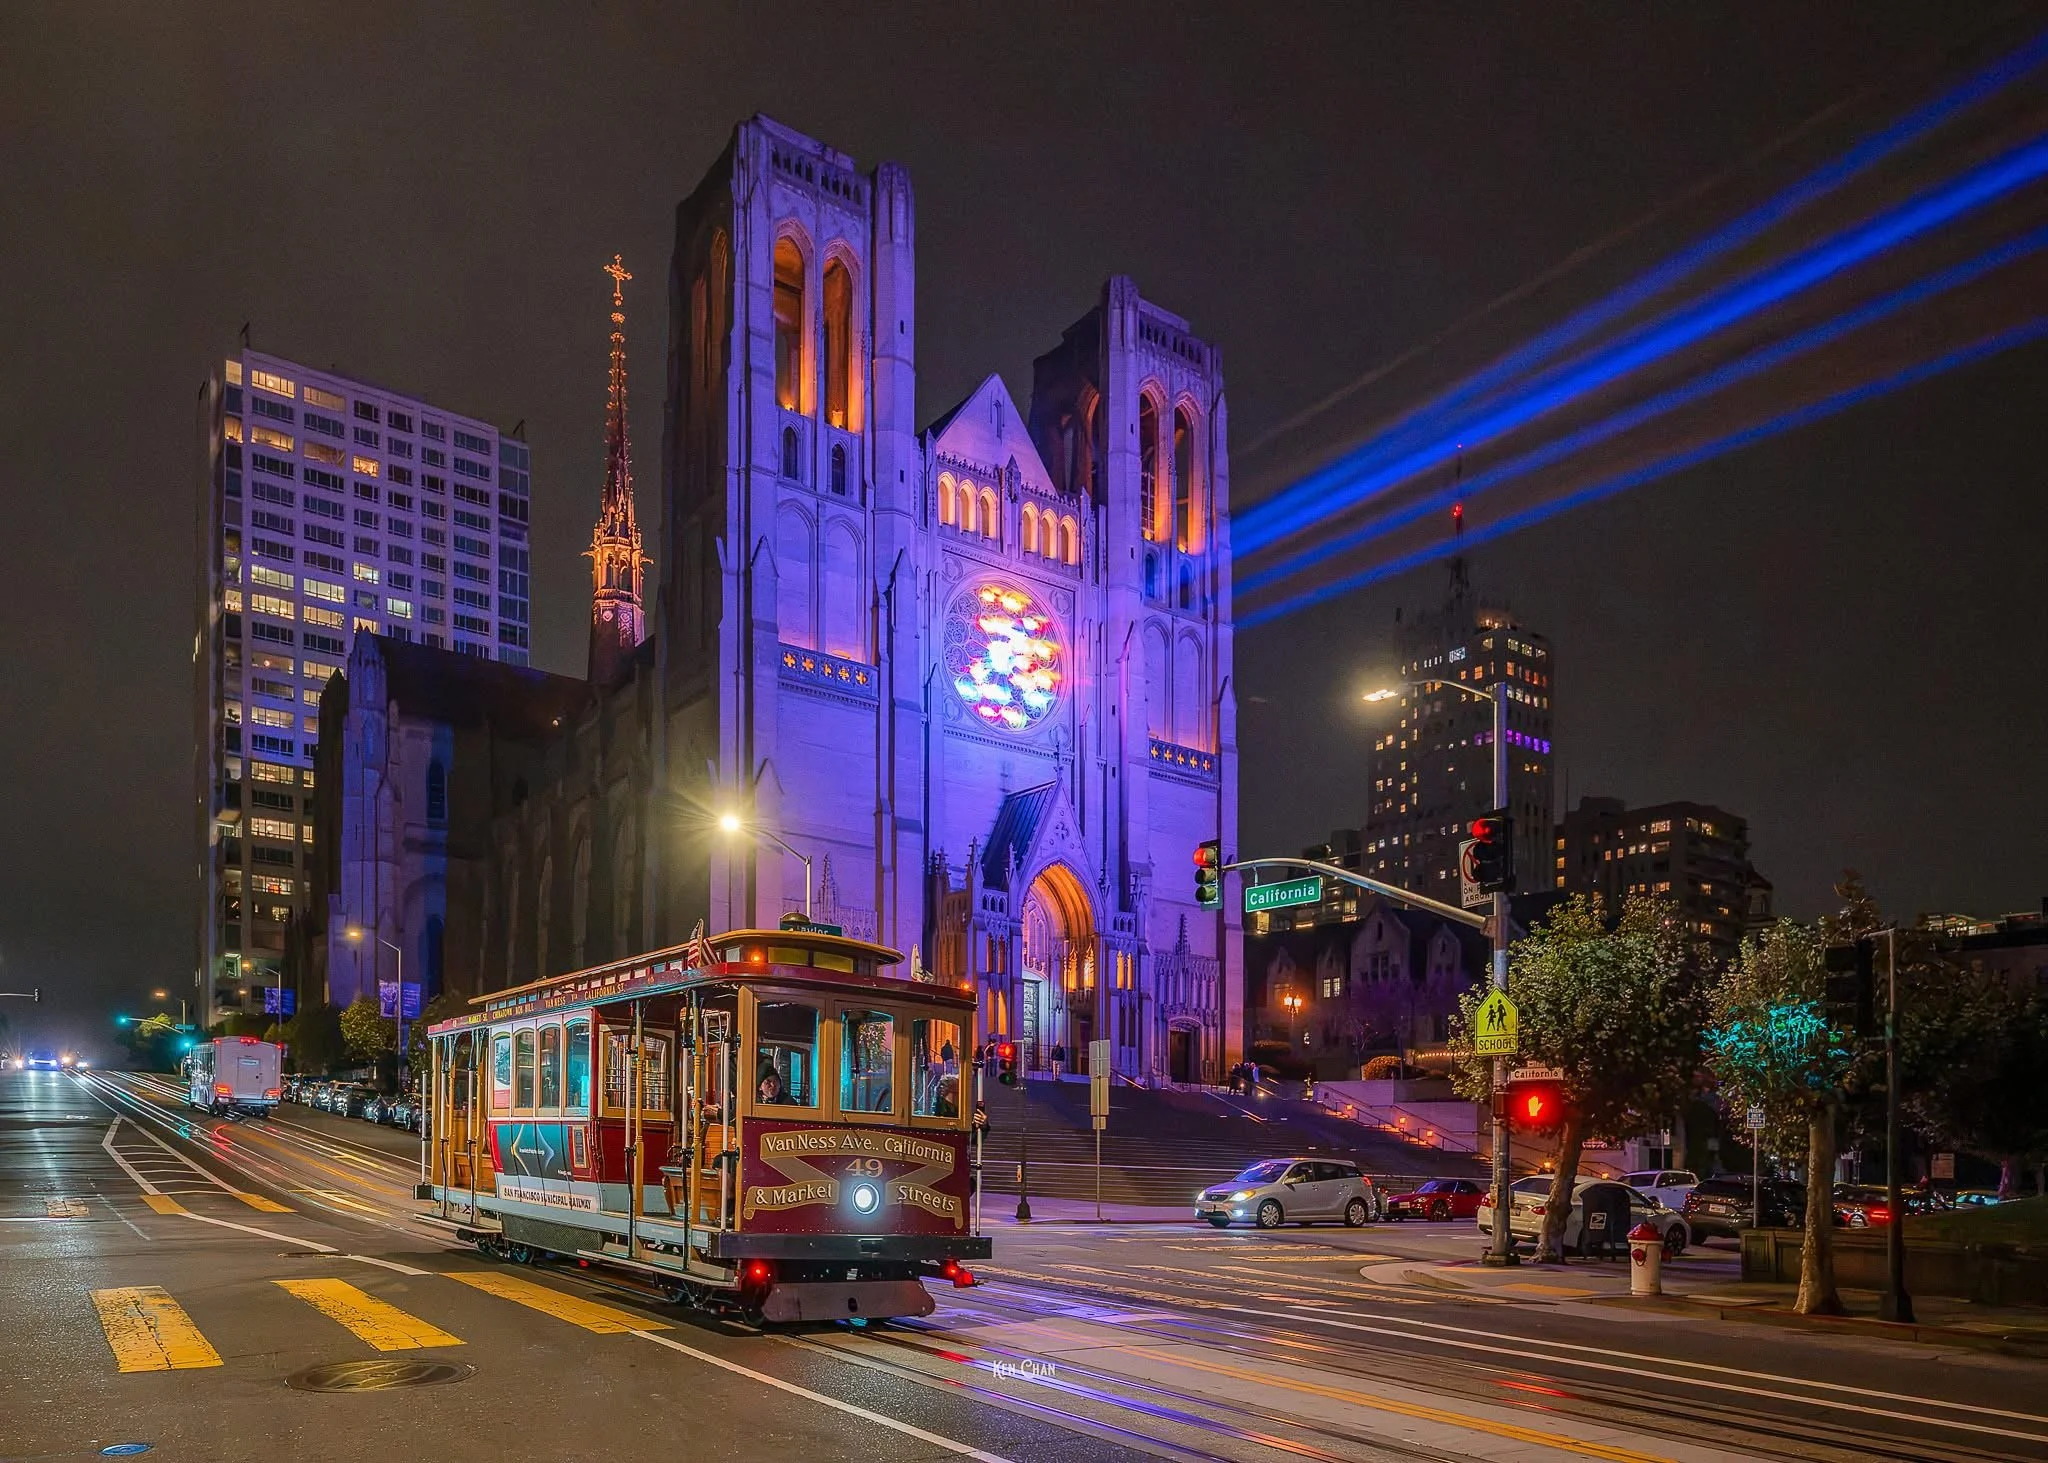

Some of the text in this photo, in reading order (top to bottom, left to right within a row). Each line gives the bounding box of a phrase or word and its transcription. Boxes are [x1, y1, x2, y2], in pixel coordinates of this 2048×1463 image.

[1250, 884, 1315, 905] California
[584, 986, 616, 1001] CALIFORNIA
[1478, 1039, 1515, 1051] SCHOOL
[1514, 1070, 1559, 1079] California
[884, 1137, 953, 1164] California
[845, 1158, 884, 1178] 49
[503, 1187, 514, 1197] SAN
[514, 1189, 540, 1202] FRANCISCO
[755, 1184, 832, 1205] & Market
[898, 1185, 955, 1212] Streets
